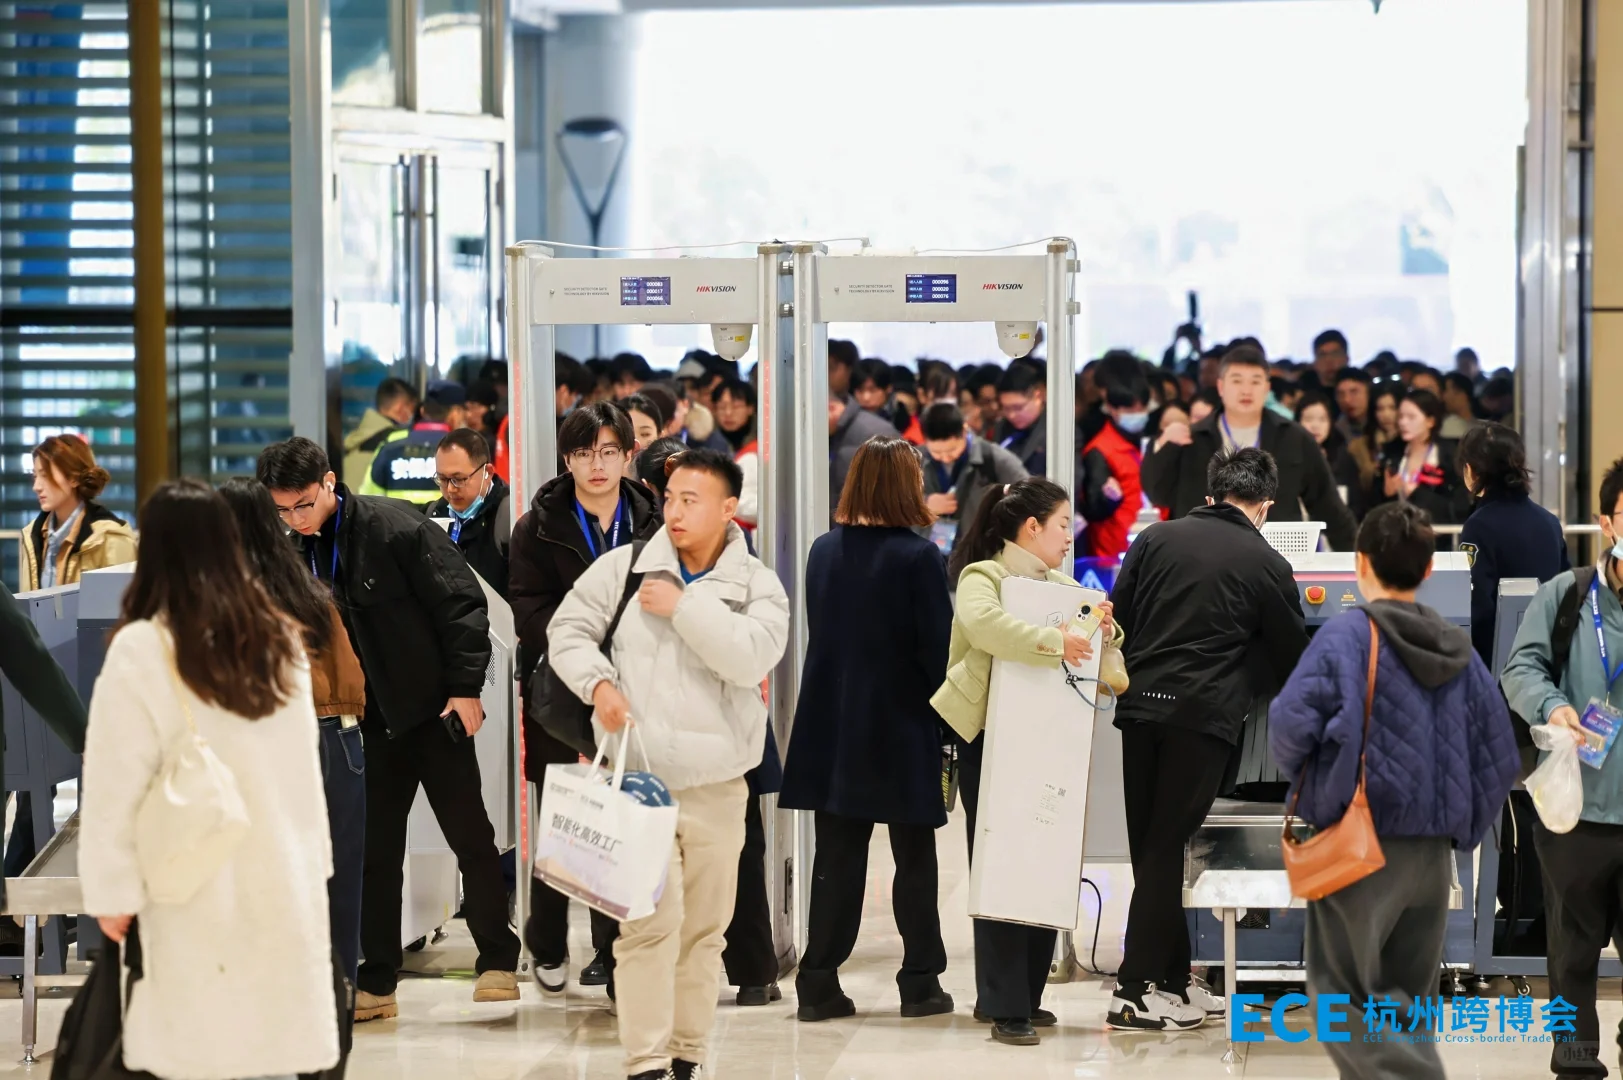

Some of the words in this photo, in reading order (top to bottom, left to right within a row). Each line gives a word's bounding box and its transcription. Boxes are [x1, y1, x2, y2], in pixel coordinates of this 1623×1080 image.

[696, 285, 737, 293] HIKVISION
[552, 812, 623, 852] 智能化高效工厂
